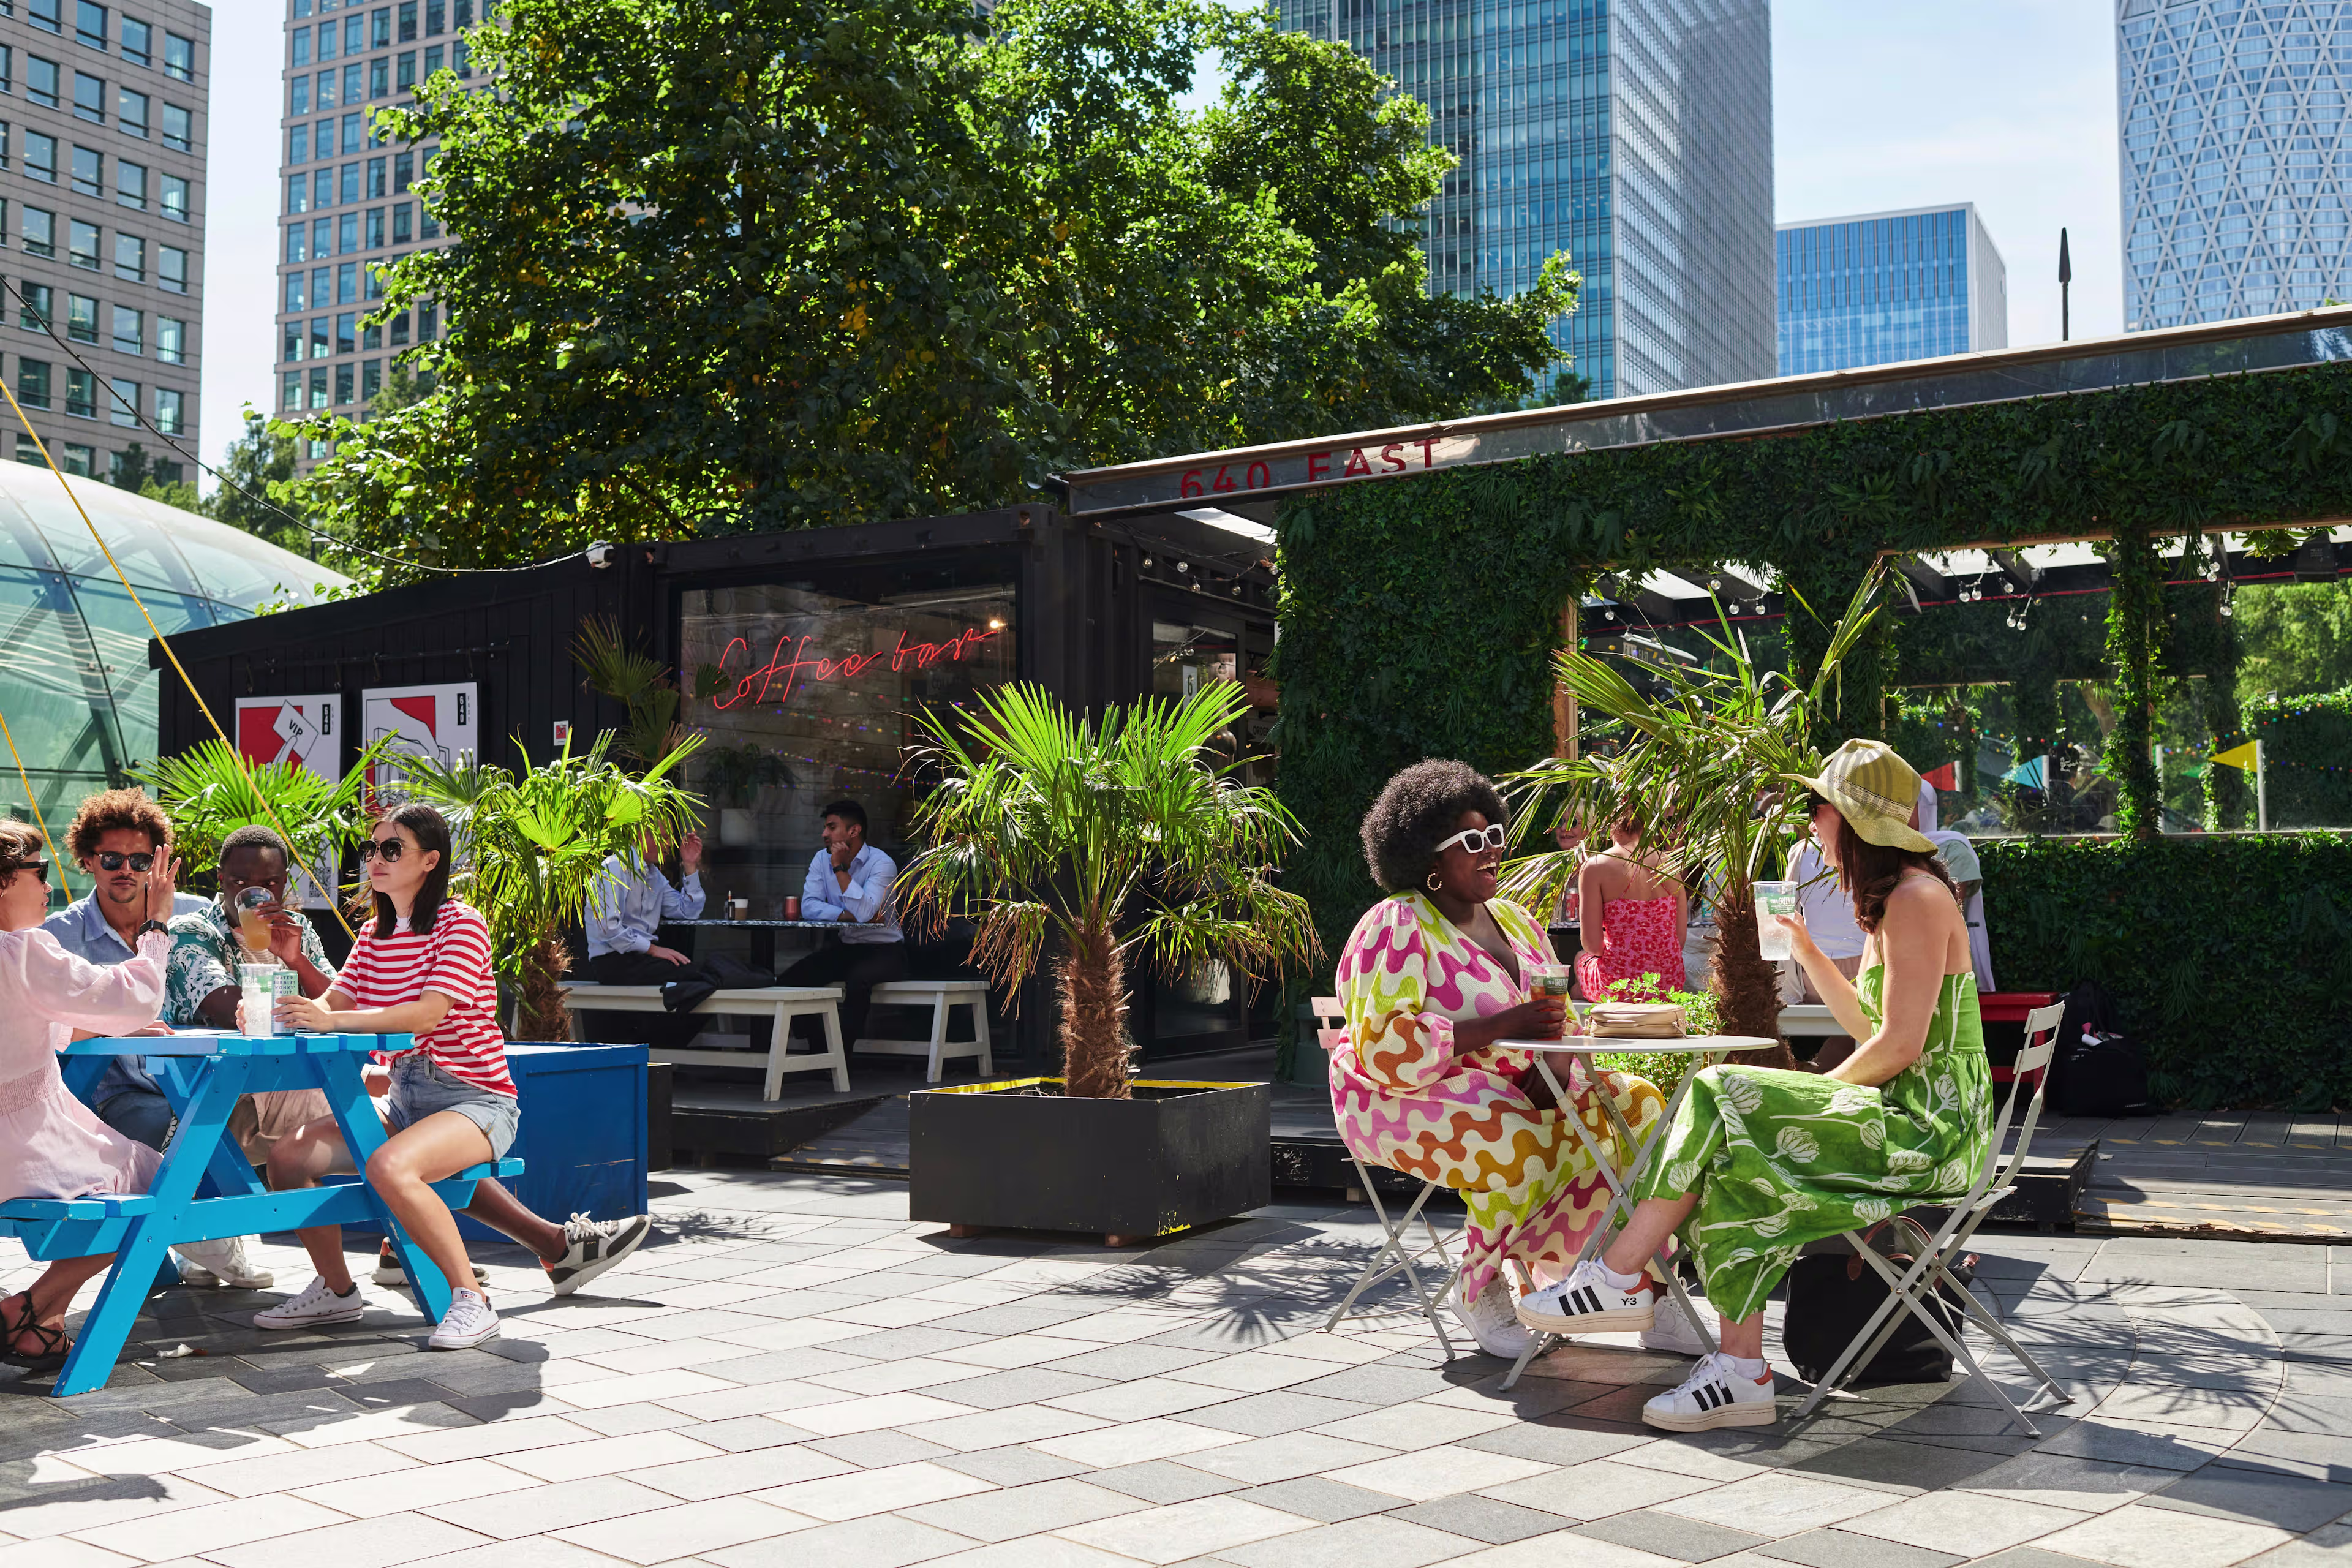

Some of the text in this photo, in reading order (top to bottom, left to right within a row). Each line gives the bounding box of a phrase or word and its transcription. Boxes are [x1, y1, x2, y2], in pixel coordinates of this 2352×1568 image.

[1180, 437, 1441, 499] 640 EAST
[714, 628, 998, 709] Coffee bar
[288, 718, 303, 736] VIP
[1621, 1297, 1637, 1306] Y-3
